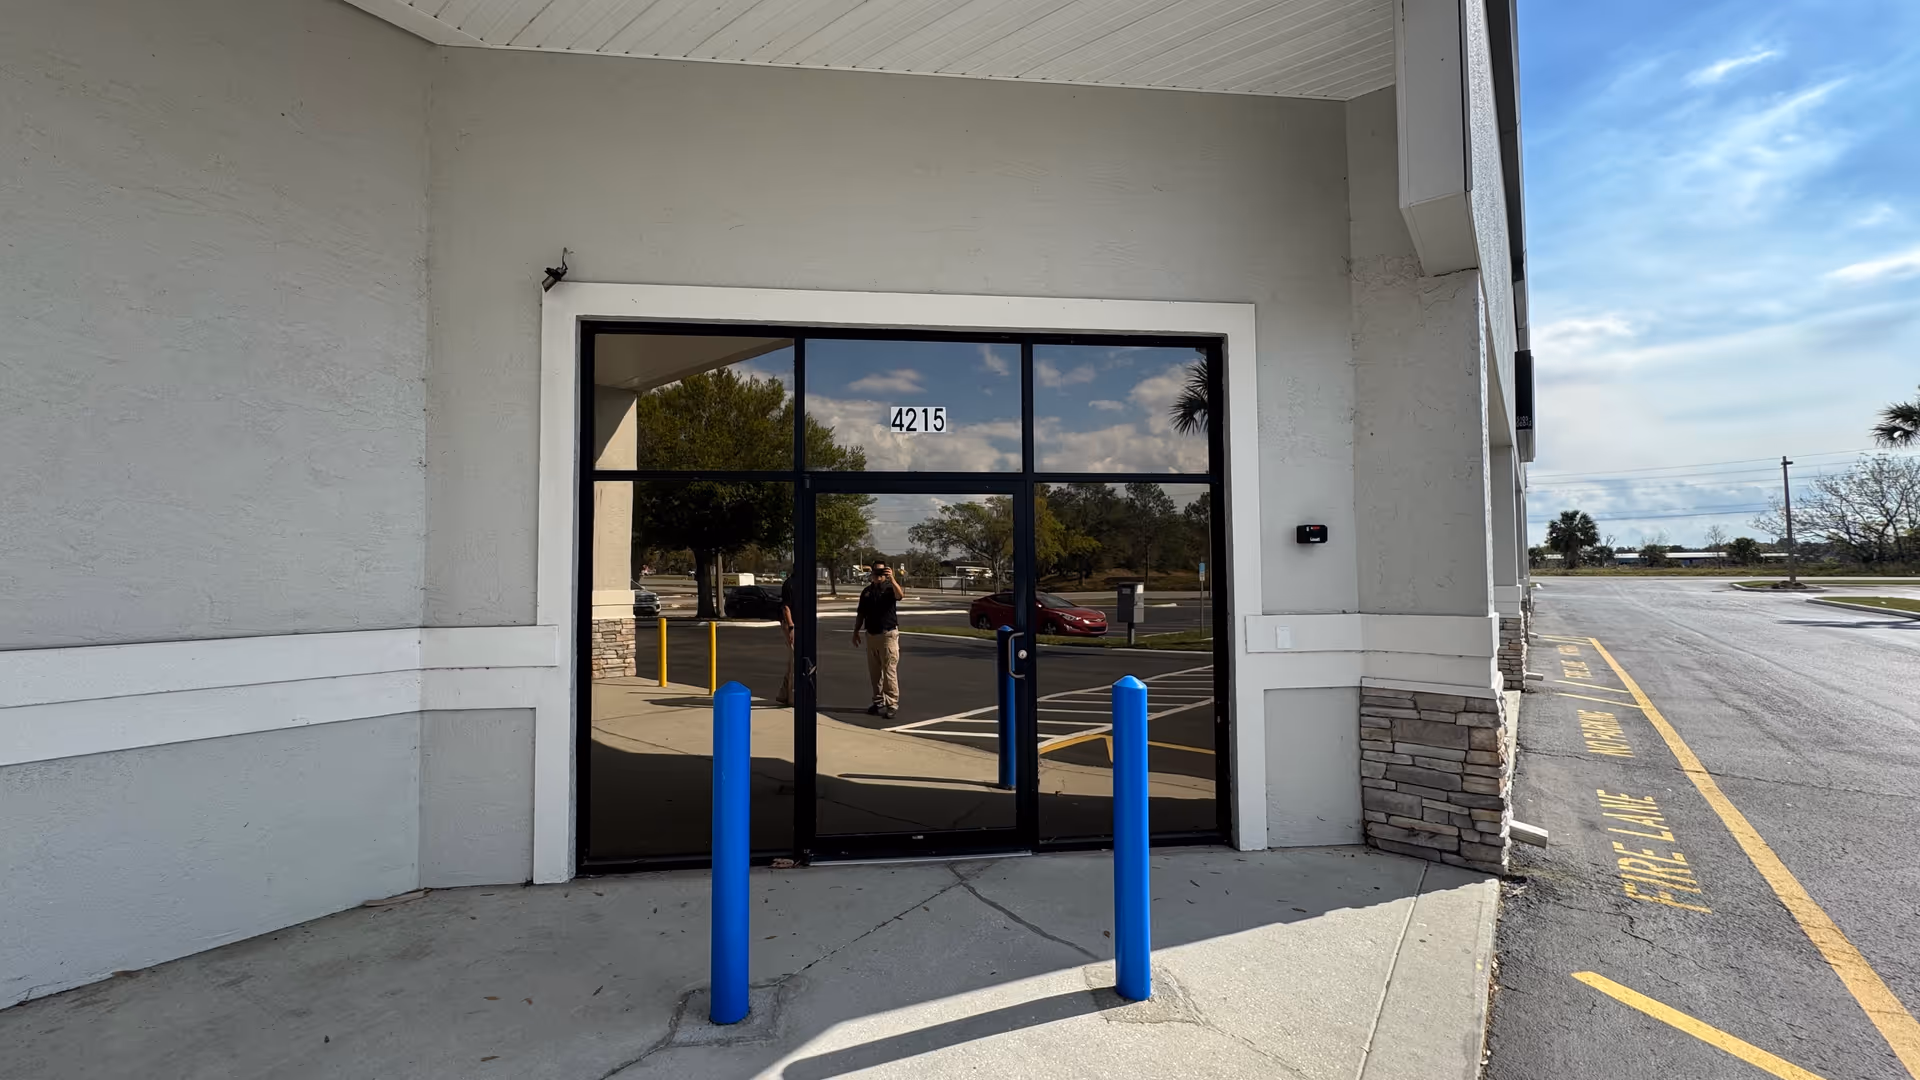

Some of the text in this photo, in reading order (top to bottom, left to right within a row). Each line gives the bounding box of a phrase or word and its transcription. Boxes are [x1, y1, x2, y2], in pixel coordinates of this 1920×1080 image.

[891, 407, 944, 431] 4215
[1595, 788, 1713, 914] FIRE LANE
